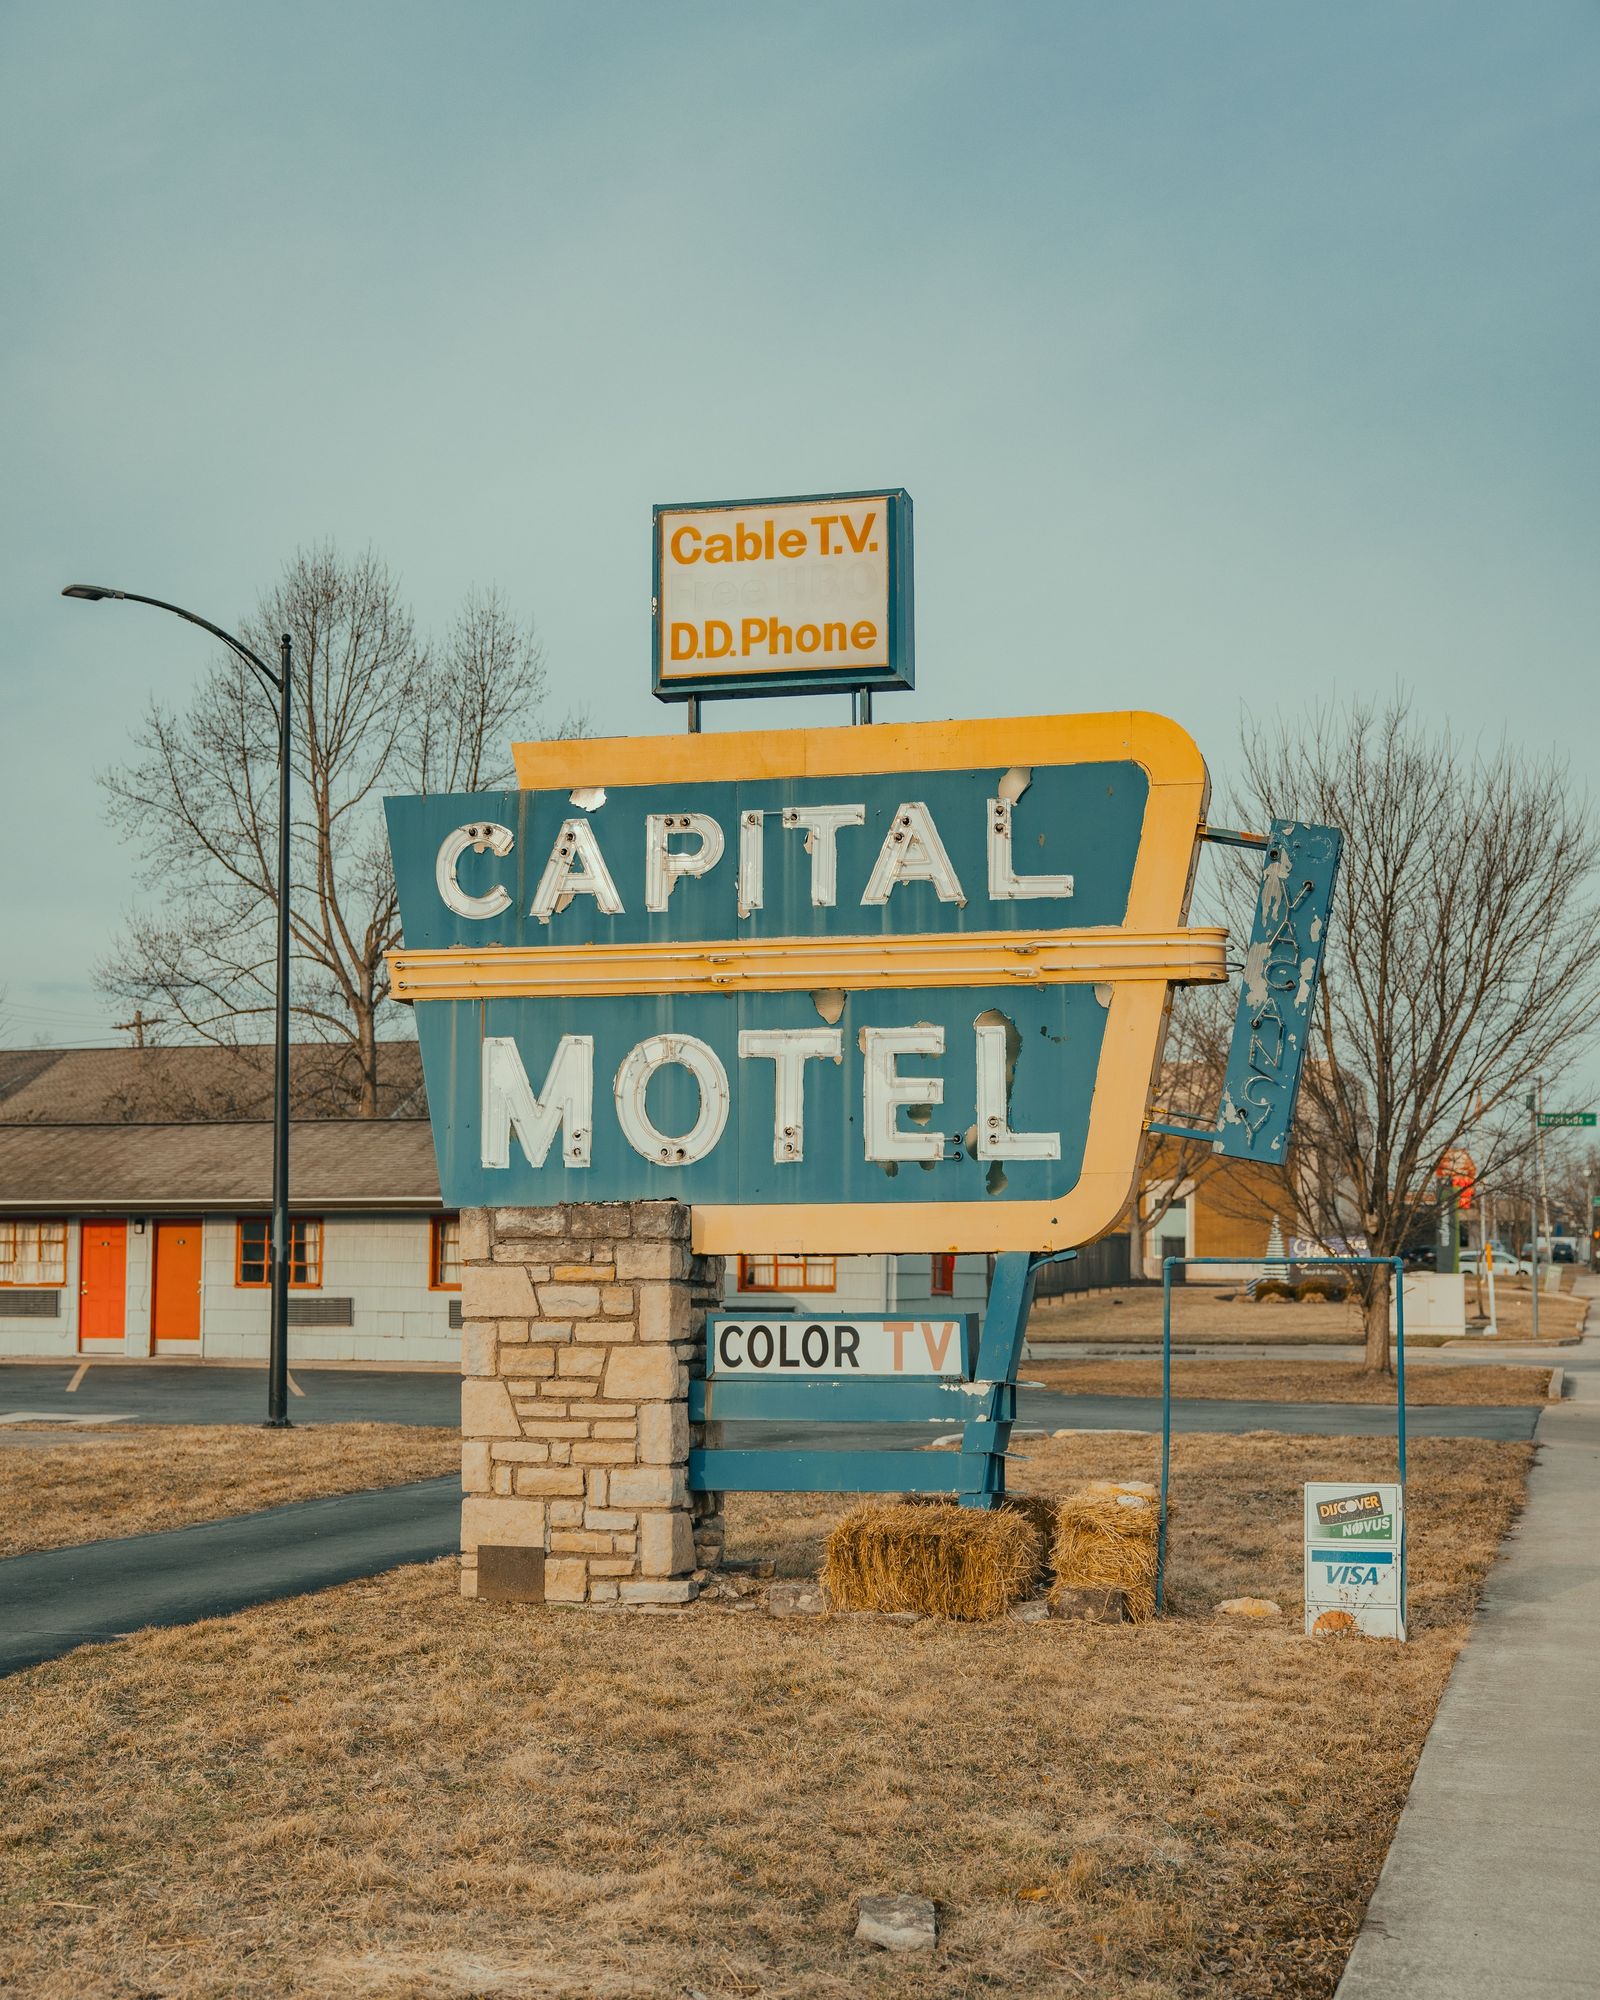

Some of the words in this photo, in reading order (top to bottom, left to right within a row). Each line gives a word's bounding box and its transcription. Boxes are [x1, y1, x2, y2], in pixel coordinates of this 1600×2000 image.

[671, 520, 807, 565] Cable
[811, 513, 878, 555] T.V.
[435, 798, 1074, 920] CAPITAL
[480, 1026, 1061, 1169] MOTEL
[720, 1324, 860, 1368] COLOR
[883, 1322, 954, 1371] TV
[1320, 1496, 1380, 1518] DISCOVER
[1342, 1516, 1390, 1537] NOVUS
[1326, 1565, 1379, 1586] VISA
